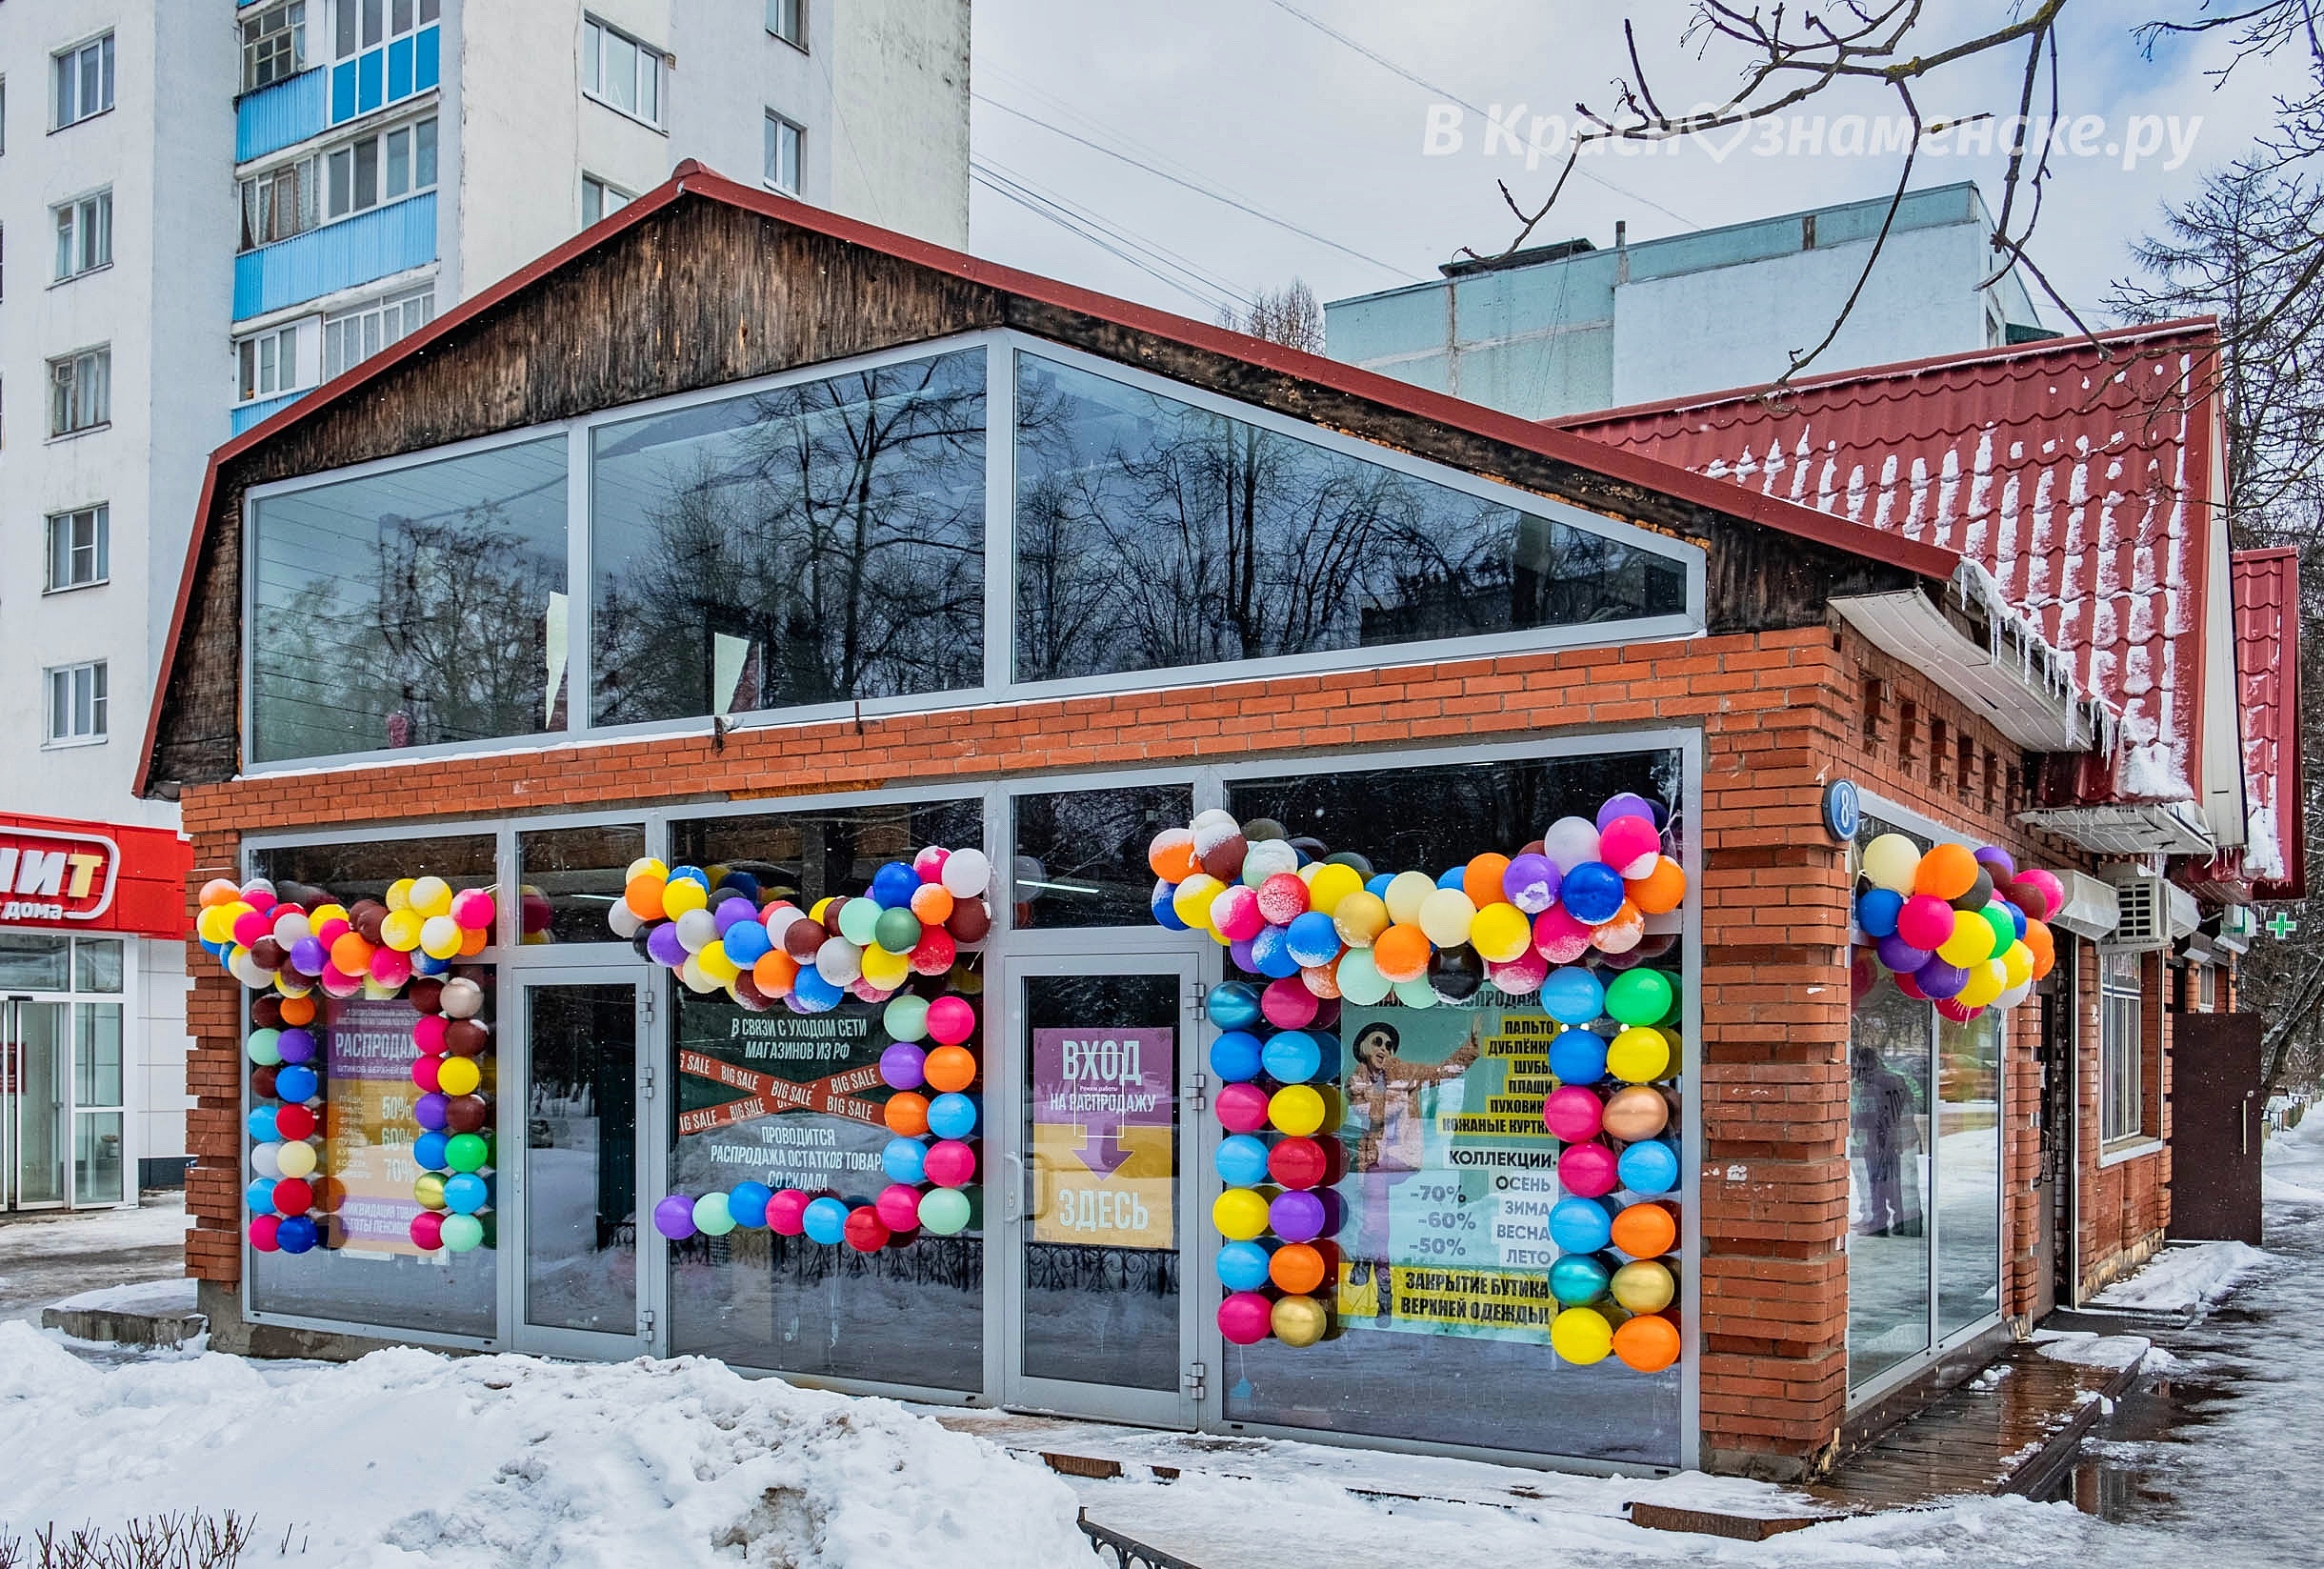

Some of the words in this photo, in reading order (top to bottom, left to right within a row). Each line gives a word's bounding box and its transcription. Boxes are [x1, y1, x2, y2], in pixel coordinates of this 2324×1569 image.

[2, 901, 63, 920] дома
[731, 1018, 740, 1036] В
[742, 1018, 776, 1036] СВЯЗИ
[778, 1019, 787, 1036] С
[788, 1019, 835, 1037] УХОДОМ
[837, 1019, 867, 1037] СЕТИ
[1505, 1021, 1553, 1035] ПАЛЬТО
[335, 1033, 421, 1061] РАСПРОДАЖ
[745, 1041, 813, 1059] МАГАЗИНОВ
[816, 1042, 831, 1060] ИЗ
[833, 1043, 851, 1060] РФ
[1062, 1039, 1142, 1086] ВХОД
[687, 1055, 710, 1075] SALE
[721, 1065, 735, 1083] BIG
[737, 1069, 759, 1091] SALE
[771, 1080, 789, 1099] BIG
[791, 1086, 812, 1107] SALE
[827, 1096, 845, 1114] BIG
[848, 1100, 872, 1121] SALE
[1509, 1080, 1553, 1096] ПЛАЩИ
[382, 1096, 412, 1120] 50%
[680, 1116, 691, 1132] IG
[693, 1110, 717, 1129] SALE
[729, 1102, 743, 1121] BIG
[744, 1097, 766, 1117] SALE
[831, 1076, 851, 1095] BIG
[852, 1068, 877, 1089] SALE
[1050, 1093, 1067, 1112] НА
[1070, 1094, 1156, 1114] РАСПРОДАЖУ
[1490, 1099, 1544, 1114] ПУХОВИК
[1442, 1118, 1506, 1133] КОЖАНЫЕ
[382, 1128, 414, 1151] 60%
[762, 1126, 835, 1147] ПРОВОДИТСЯ
[711, 1145, 787, 1167] РАСПРОДАЖА
[788, 1150, 843, 1169] ОСТАТКОВ
[845, 1152, 884, 1172] ТОВАР
[384, 1158, 415, 1182] 70%
[768, 1171, 783, 1188] СО
[785, 1172, 828, 1192] СКЛАДА
[1495, 1176, 1551, 1192] ОСЕНЬ
[1411, 1184, 1466, 1204] -70%
[1058, 1188, 1150, 1233] ЗДЕСЬ
[1505, 1200, 1550, 1216] ЗИМА
[1418, 1212, 1475, 1230] -60%
[1497, 1223, 1551, 1240] ВЕСНА
[1410, 1238, 1466, 1256] -50%
[1506, 1249, 1551, 1264] ЛЕТО
[1405, 1272, 1487, 1294] ЗАКРЫТИЕ
[1492, 1277, 1549, 1298] БУТИКА
[1401, 1297, 1466, 1318] ВЕРХНЕЙ
